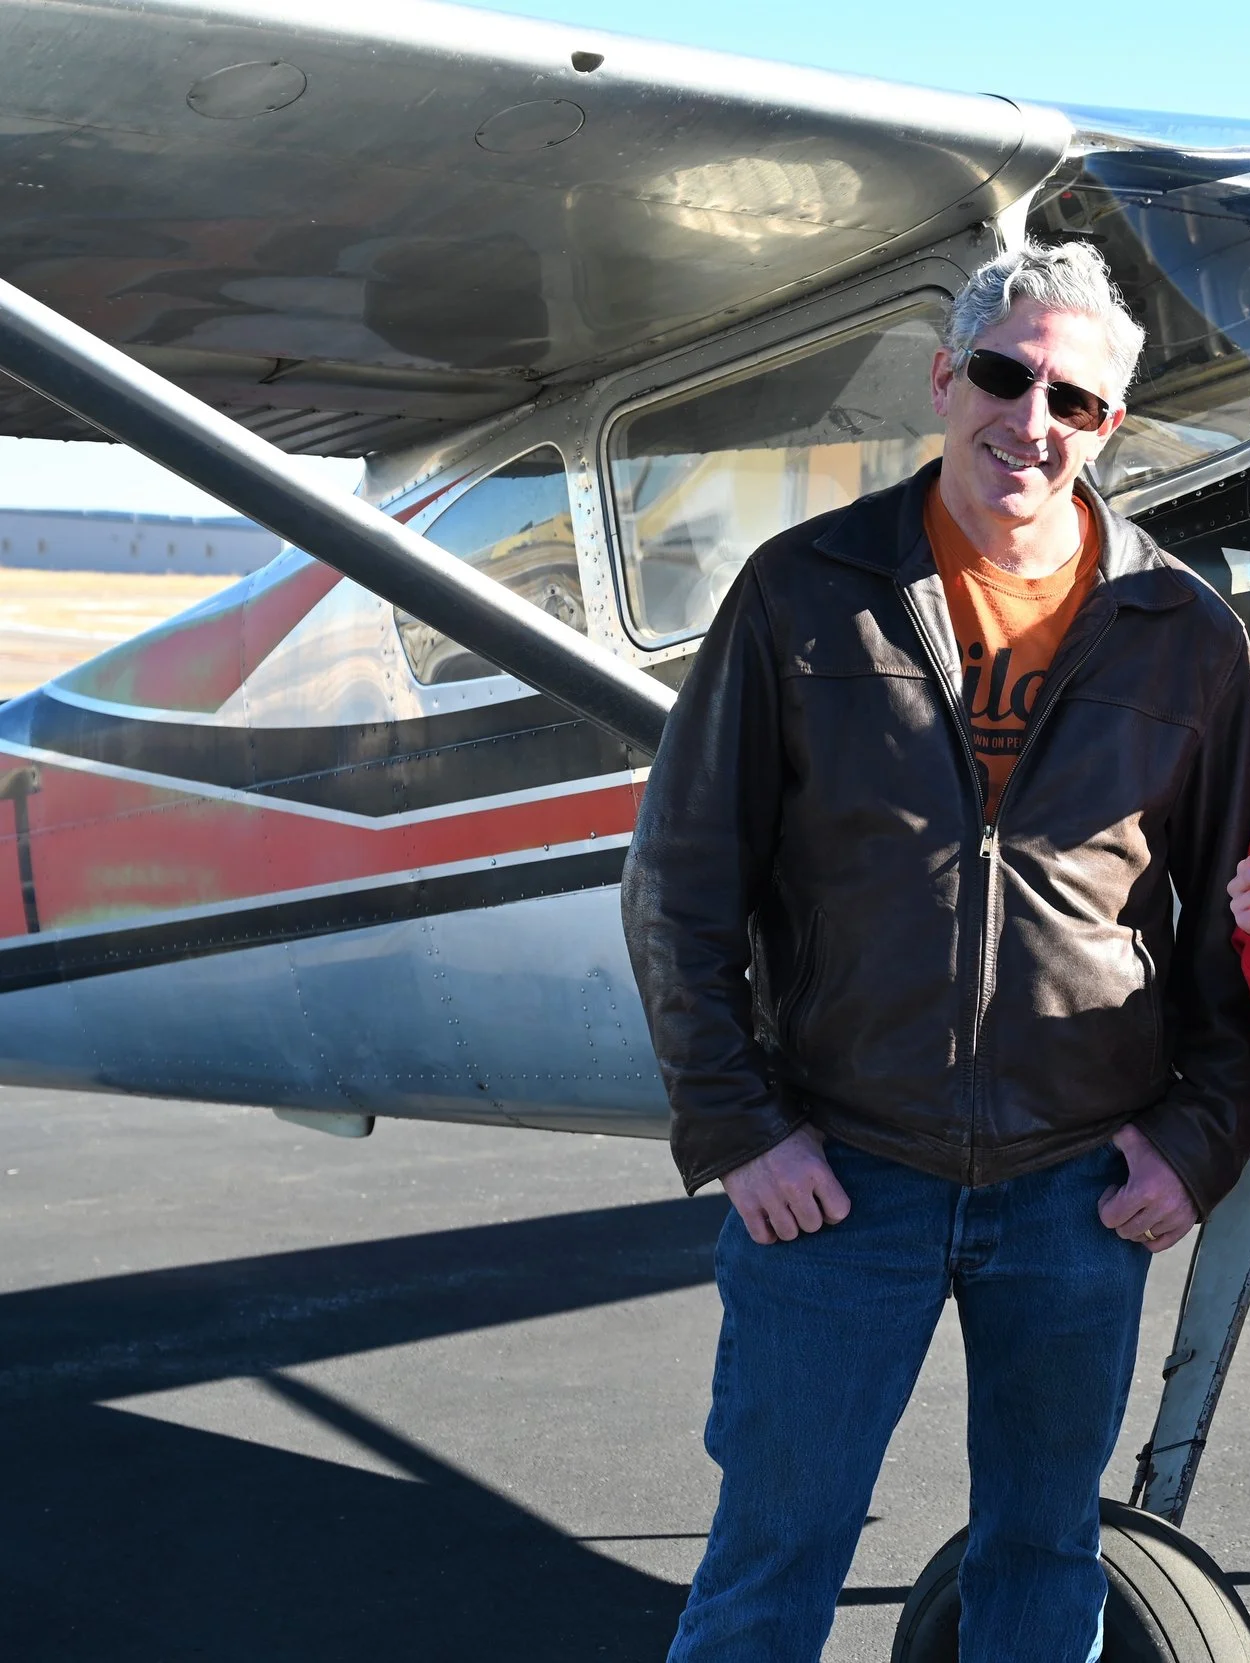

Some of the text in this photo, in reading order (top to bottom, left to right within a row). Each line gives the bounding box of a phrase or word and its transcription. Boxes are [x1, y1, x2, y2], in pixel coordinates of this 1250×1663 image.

[973, 733, 1023, 748] WN ON PE
